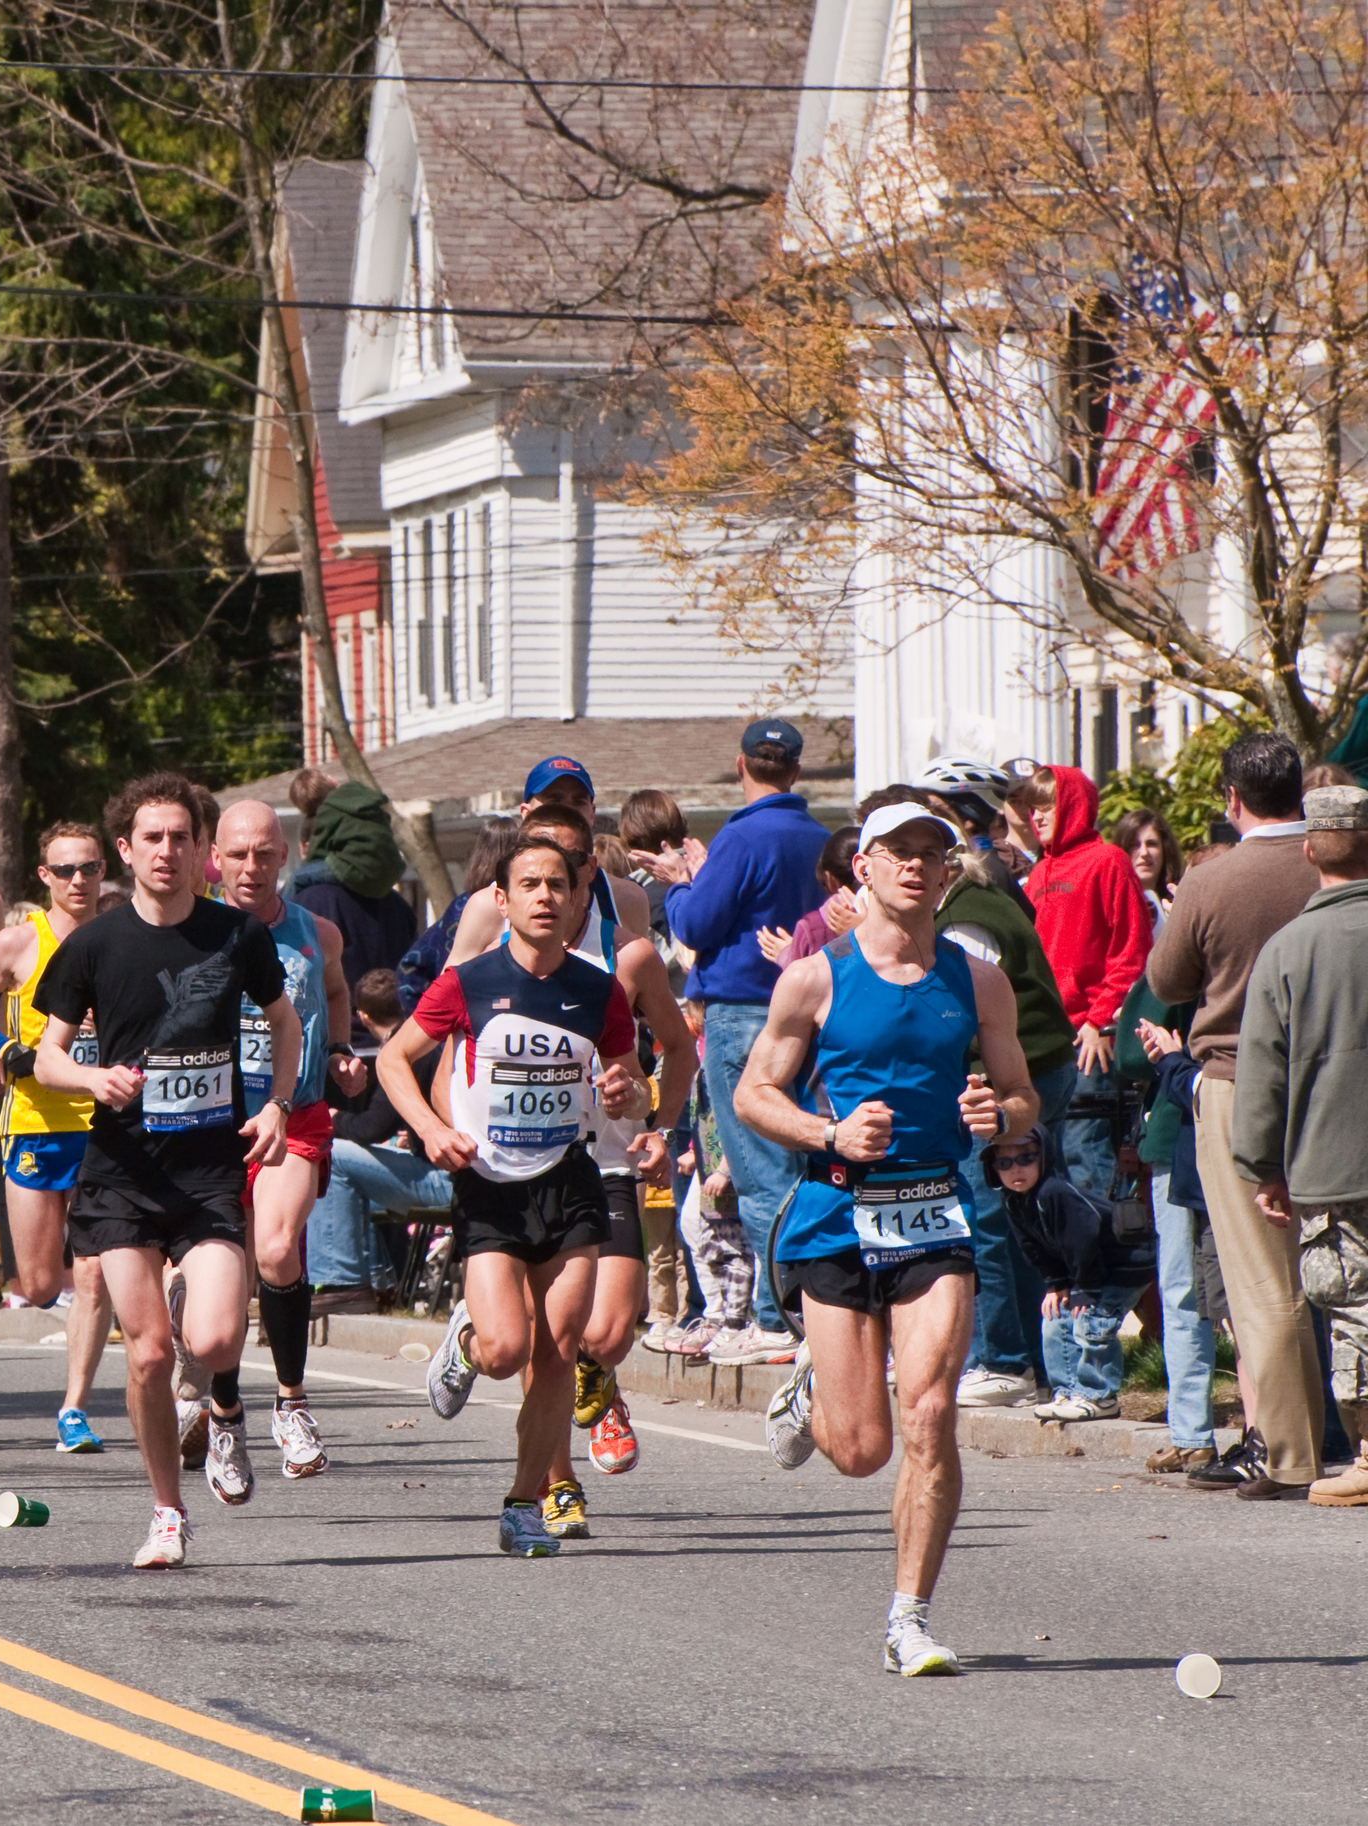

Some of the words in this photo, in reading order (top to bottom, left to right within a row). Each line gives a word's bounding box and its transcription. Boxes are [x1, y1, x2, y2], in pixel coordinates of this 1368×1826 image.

[1312, 819, 1345, 829] CRAINE
[505, 1034, 573, 1058] USA
[182, 1050, 230, 1066] adidas
[530, 1068, 579, 1082] adidas
[158, 1072, 222, 1100] 1061
[243, 1081, 265, 1089] ATHON
[504, 1090, 571, 1116] 1069
[161, 1118, 199, 1126] MARATHON
[504, 1135, 543, 1143] MARATHON
[899, 1181, 950, 1200] adidas
[871, 1205, 951, 1236] 1145
[899, 1247, 926, 1256] BOSTON
[881, 1255, 920, 1263] MARAT
